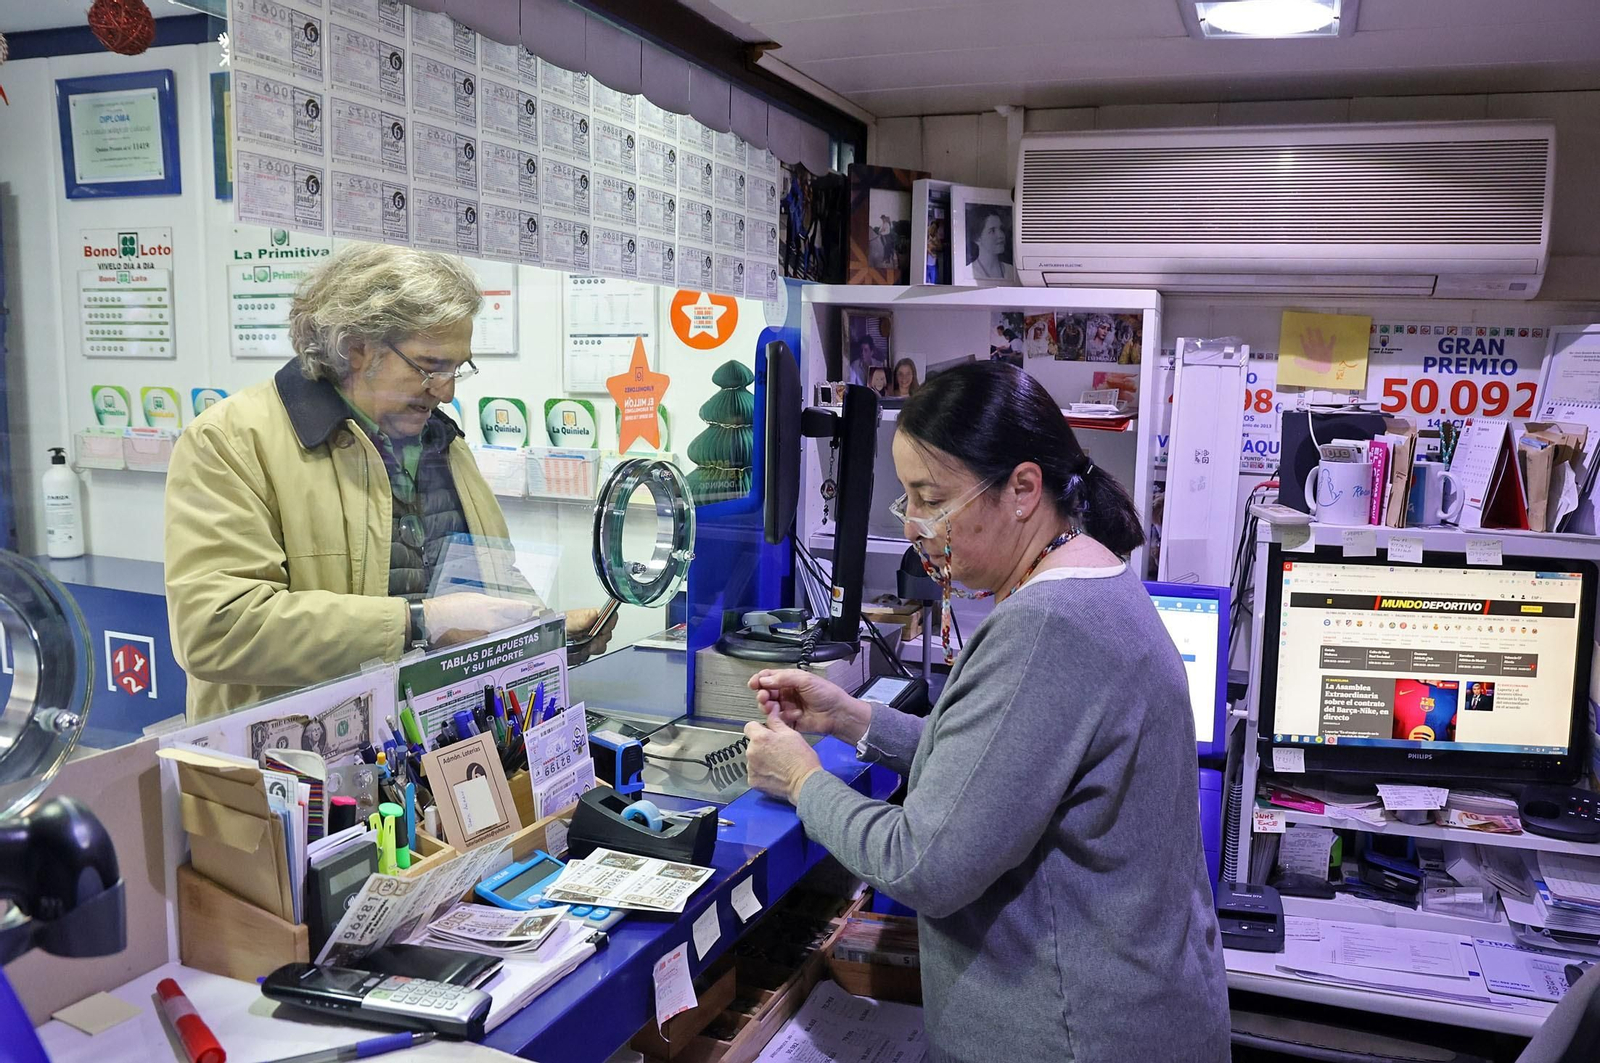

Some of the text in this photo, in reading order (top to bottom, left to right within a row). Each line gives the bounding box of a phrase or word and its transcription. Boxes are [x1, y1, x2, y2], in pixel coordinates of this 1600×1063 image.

[99, 114, 131, 123] DIPLOMA
[84, 244, 171, 257] Bono Loto
[234, 247, 330, 260] La Primitiva
[242, 272, 253, 281] La
[1437, 336, 1505, 357] GRAN
[1423, 356, 1518, 376] PREMIO
[1380, 377, 1538, 418] 50.092
[1427, 418, 1440, 428] 14
[494, 424, 521, 434] Quiniela
[552, 426, 590, 435] La Quiniela
[1380, 598, 1483, 612] MUNDODEPORTIVO
[440, 632, 540, 671] TABLAS DE APUESTAS
[463, 649, 524, 675] Y SU IMPORTE
[1335, 683, 1372, 691] Asamblea
[1325, 690, 1379, 699] Extraordinaria
[1324, 698, 1346, 706] sobre
[1336, 707, 1379, 716] Barça-Nike,
[1323, 713, 1350, 721] directo
[1407, 752, 1433, 760] PHILIPS
[543, 754, 571, 777] 82199
[343, 895, 382, 940] 96481
